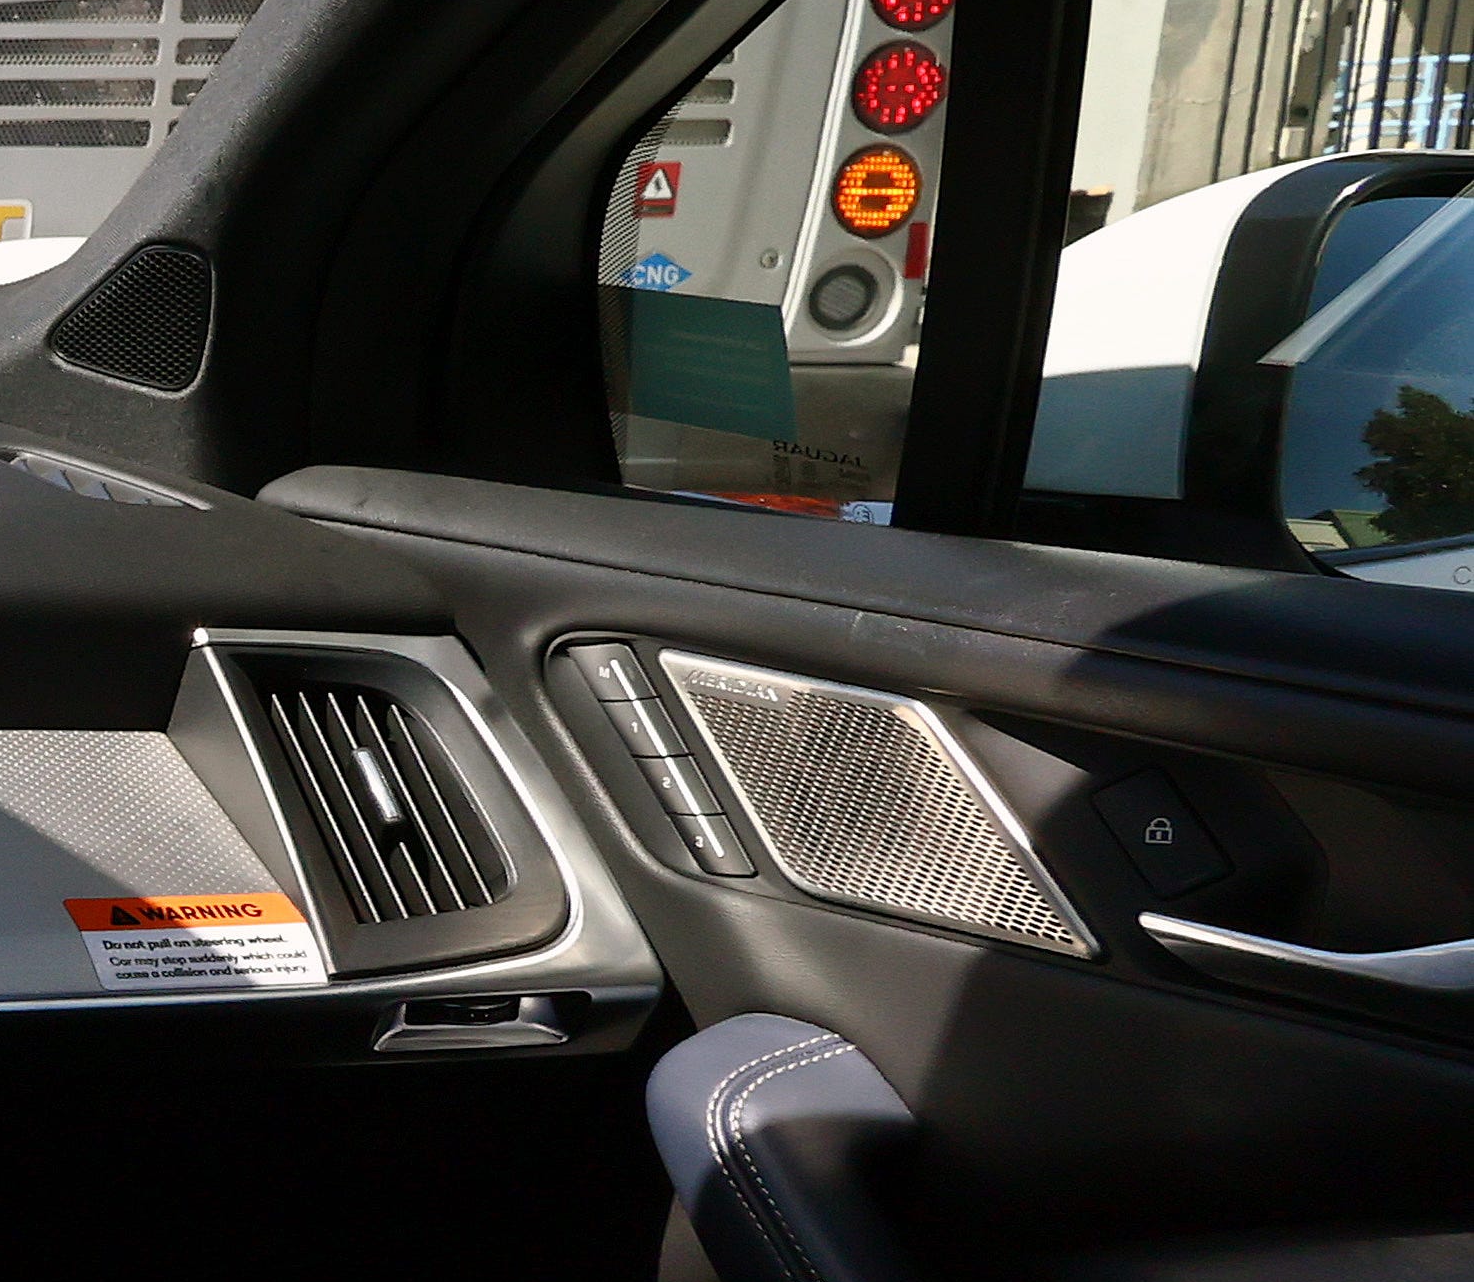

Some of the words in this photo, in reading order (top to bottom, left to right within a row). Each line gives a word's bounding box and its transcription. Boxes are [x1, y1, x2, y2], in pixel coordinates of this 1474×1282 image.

[631, 264, 680, 286] CNG
[137, 903, 263, 922] WARNING
[103, 940, 121, 950] Do
[124, 940, 146, 949] not
[148, 938, 172, 950] pull
[174, 939, 191, 948] on
[193, 935, 245, 948] steering
[110, 957, 132, 966] Car
[135, 958, 159, 967] may
[162, 956, 187, 967] stop
[189, 952, 238, 965] suddenly
[242, 951, 274, 960] which
[277, 950, 307, 959] could
[116, 971, 150, 979] cause
[161, 967, 208, 978] collision
[210, 965, 232, 976] and
[235, 967, 273, 976] serious
